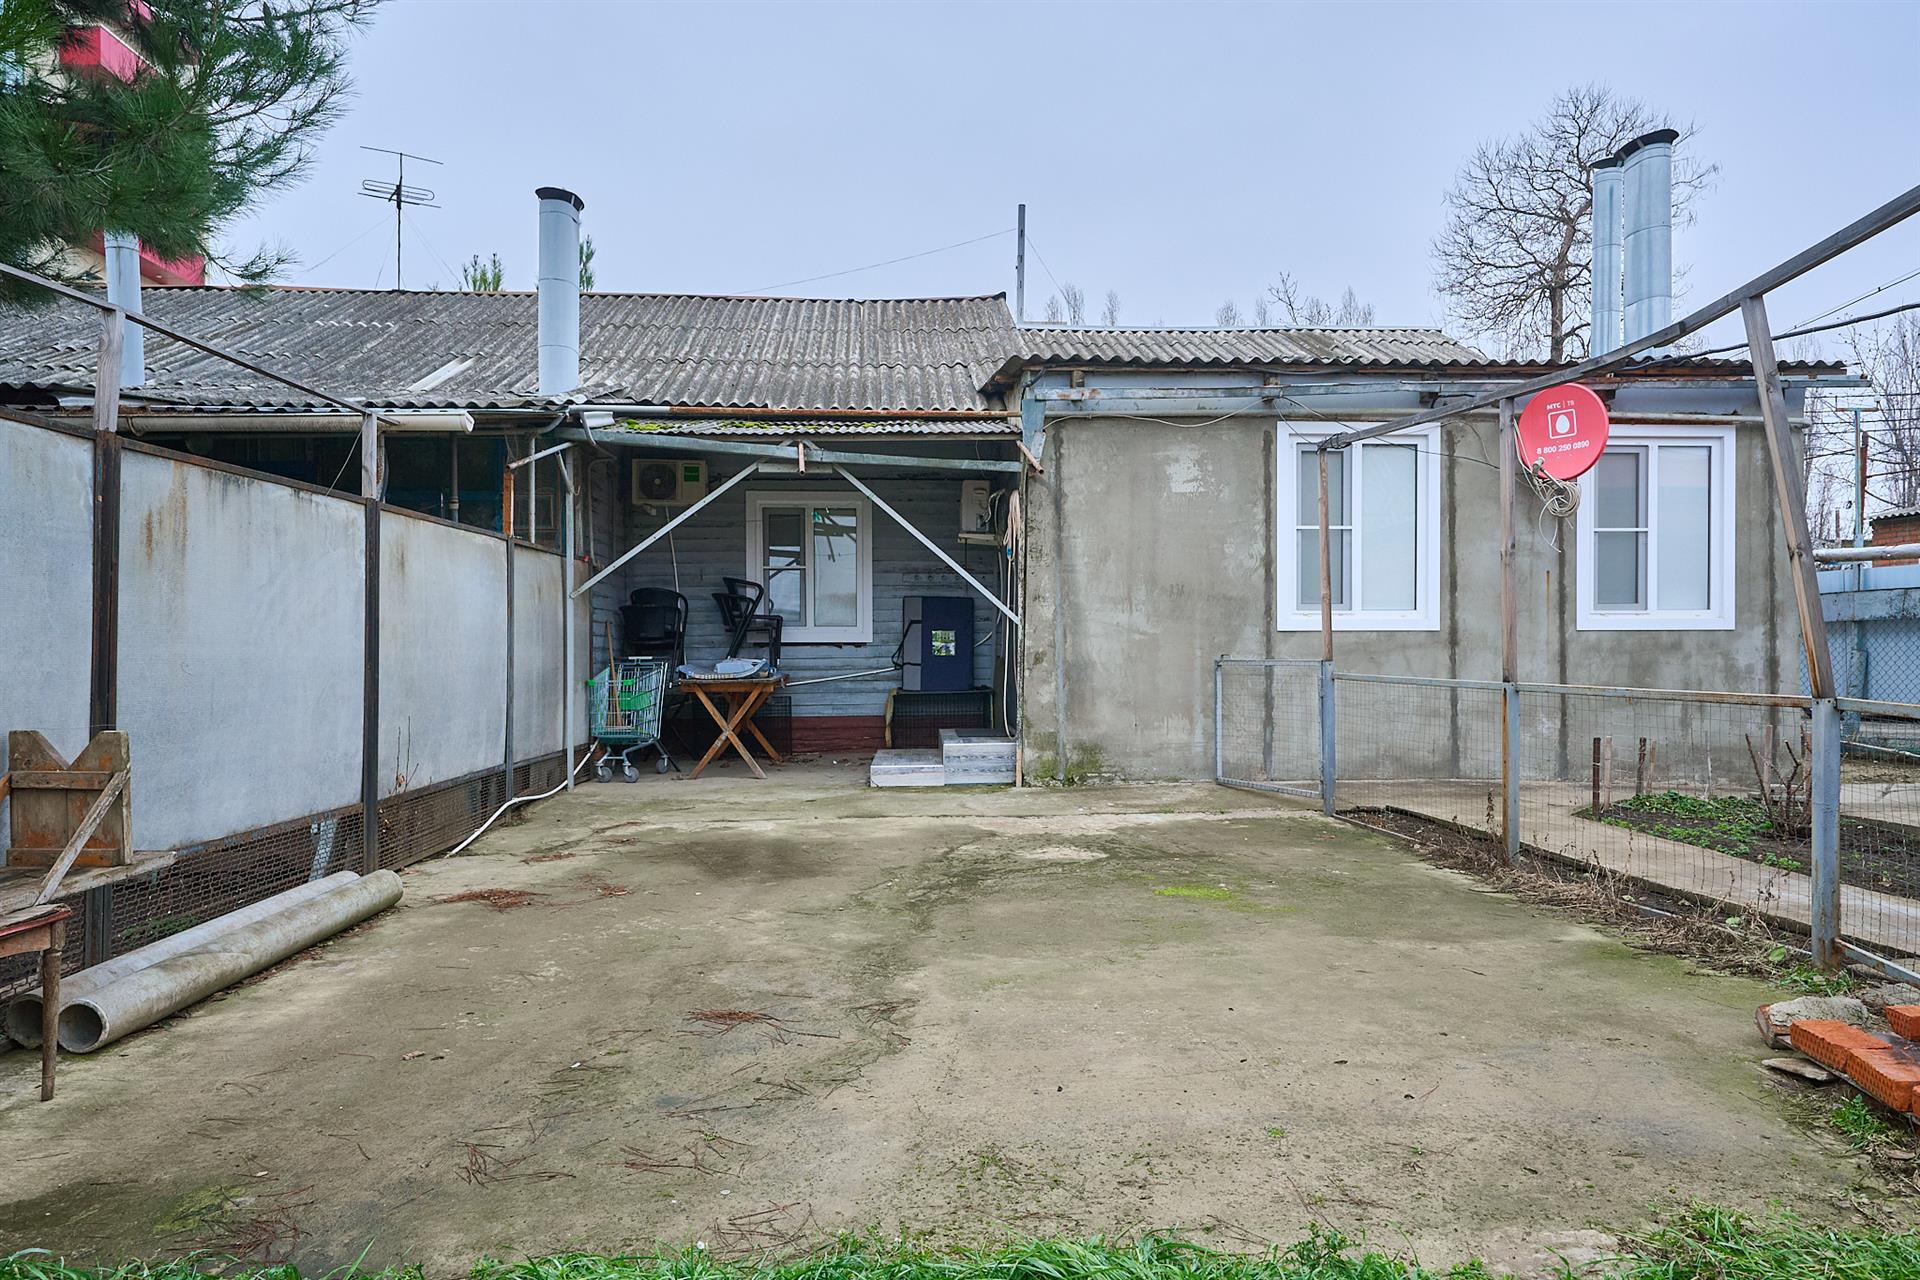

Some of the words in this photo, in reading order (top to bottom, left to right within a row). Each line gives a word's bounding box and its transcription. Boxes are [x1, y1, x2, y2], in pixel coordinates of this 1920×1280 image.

[1546, 402, 1561, 410] МТС
[1543, 446, 1557, 454] 800
[1558, 443, 1571, 452] 250
